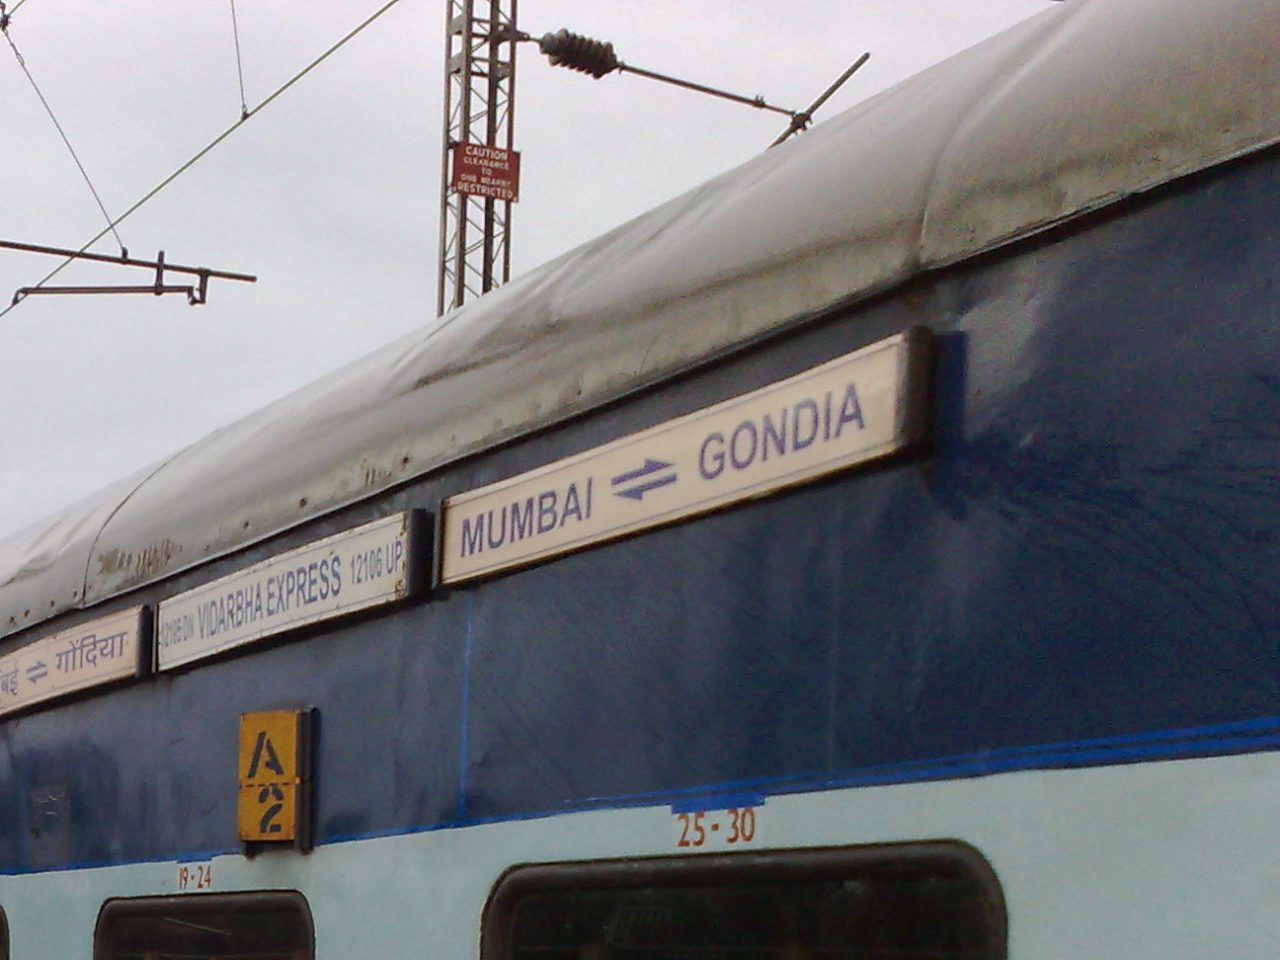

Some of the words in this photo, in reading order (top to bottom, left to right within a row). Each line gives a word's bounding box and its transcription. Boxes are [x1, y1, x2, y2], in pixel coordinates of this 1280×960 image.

[463, 156, 509, 170] CLEARANCE
[465, 145, 508, 160] CAUTION
[481, 167, 492, 175] TO
[457, 181, 514, 199] RESTRICTED
[460, 477, 594, 558] MUMBAI
[698, 382, 865, 481] GONDIA
[198, 582, 264, 640] VIDARBHA
[266, 555, 341, 616] EXPRESS
[351, 547, 382, 584] 12106
[386, 540, 402, 574] UP
[56, 631, 128, 673] गोंदिया
[248, 731, 284, 778] A
[258, 784, 285, 833] 2
